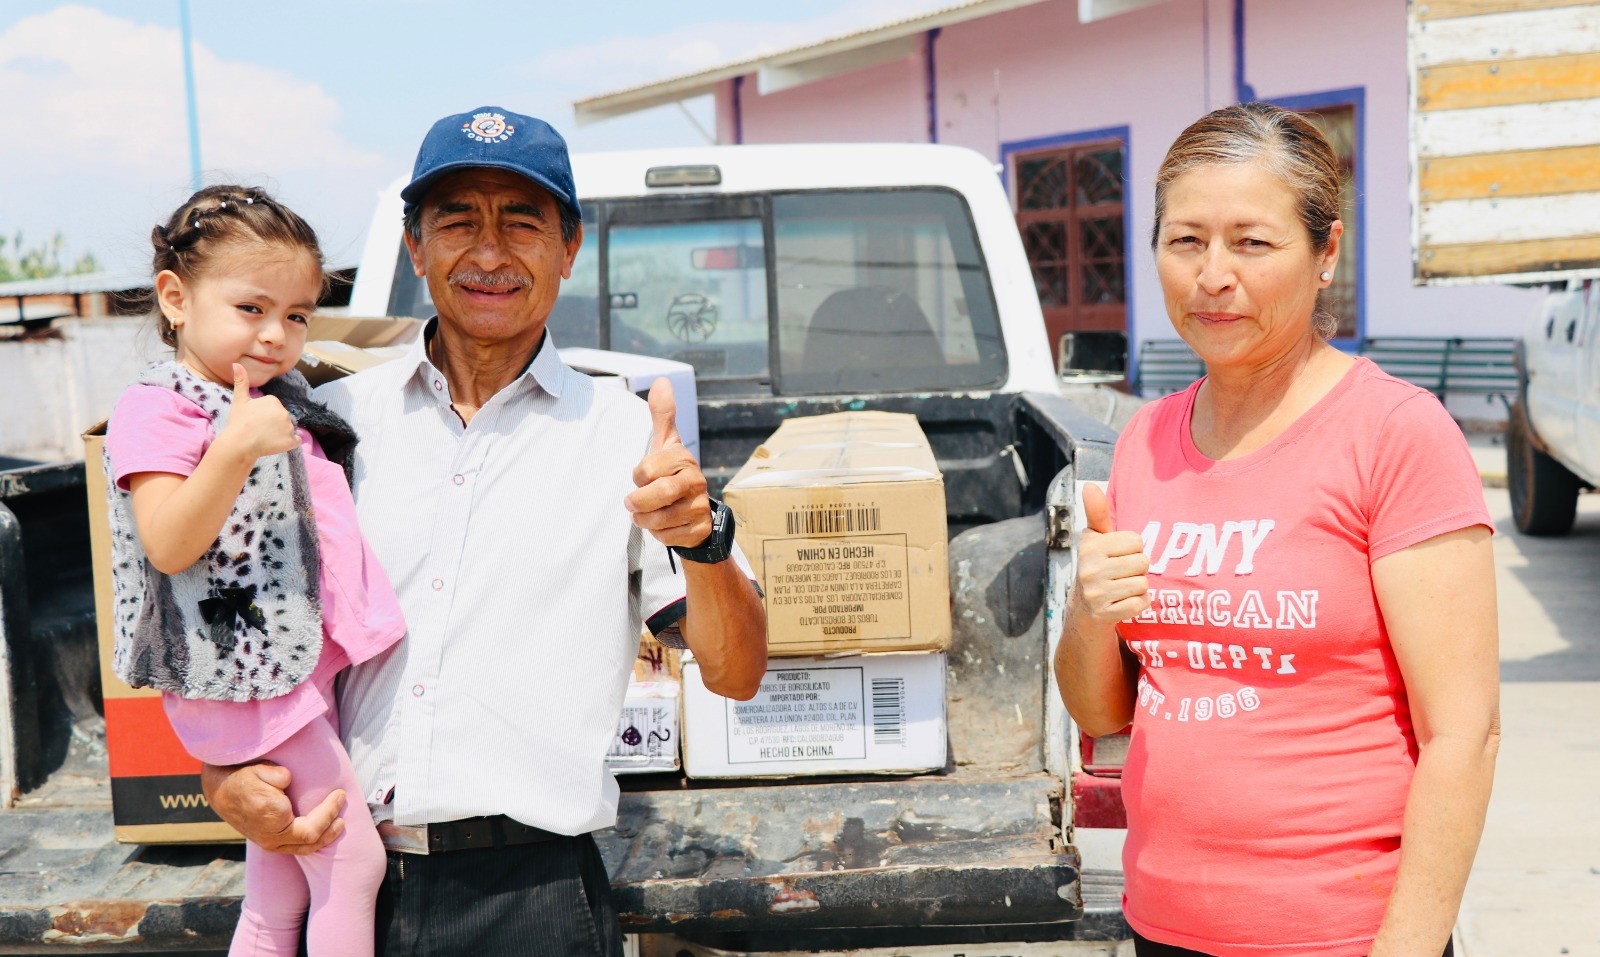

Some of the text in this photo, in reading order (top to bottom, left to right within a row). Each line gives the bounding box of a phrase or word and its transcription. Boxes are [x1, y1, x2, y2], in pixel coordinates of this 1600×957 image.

[797, 546, 874, 560] HECHO EN CHINA
[836, 562, 850, 570] RFC:
[813, 573, 821, 582] DE
[823, 572, 842, 582] LAGOS
[881, 570, 892, 579] LOS
[893, 570, 901, 578] DE
[786, 574, 811, 584] MORENO
[792, 585, 804, 593] COL.
[850, 583, 858, 591] LA
[865, 580, 902, 590] CARRETERA
[774, 586, 790, 594] PLAN
[783, 597, 792, 605] DE
[804, 595, 823, 603] ALTOS
[827, 594, 838, 602] LOS
[841, 592, 902, 601] COMERCIALIZADORA
[828, 605, 864, 613] IMPORTADO
[1121, 590, 1319, 630] ERICAN
[799, 614, 878, 625] TUBOS DE BOROSILICATO
[822, 626, 856, 635] PRODUCTO:
[760, 684, 778, 692] TUBOS
[789, 682, 830, 690] BOROSILICATO
[733, 705, 791, 714] COMERCIALIZADORA
[733, 716, 768, 725] CARRETERA
[760, 745, 833, 758] HECHO EN CHINA
